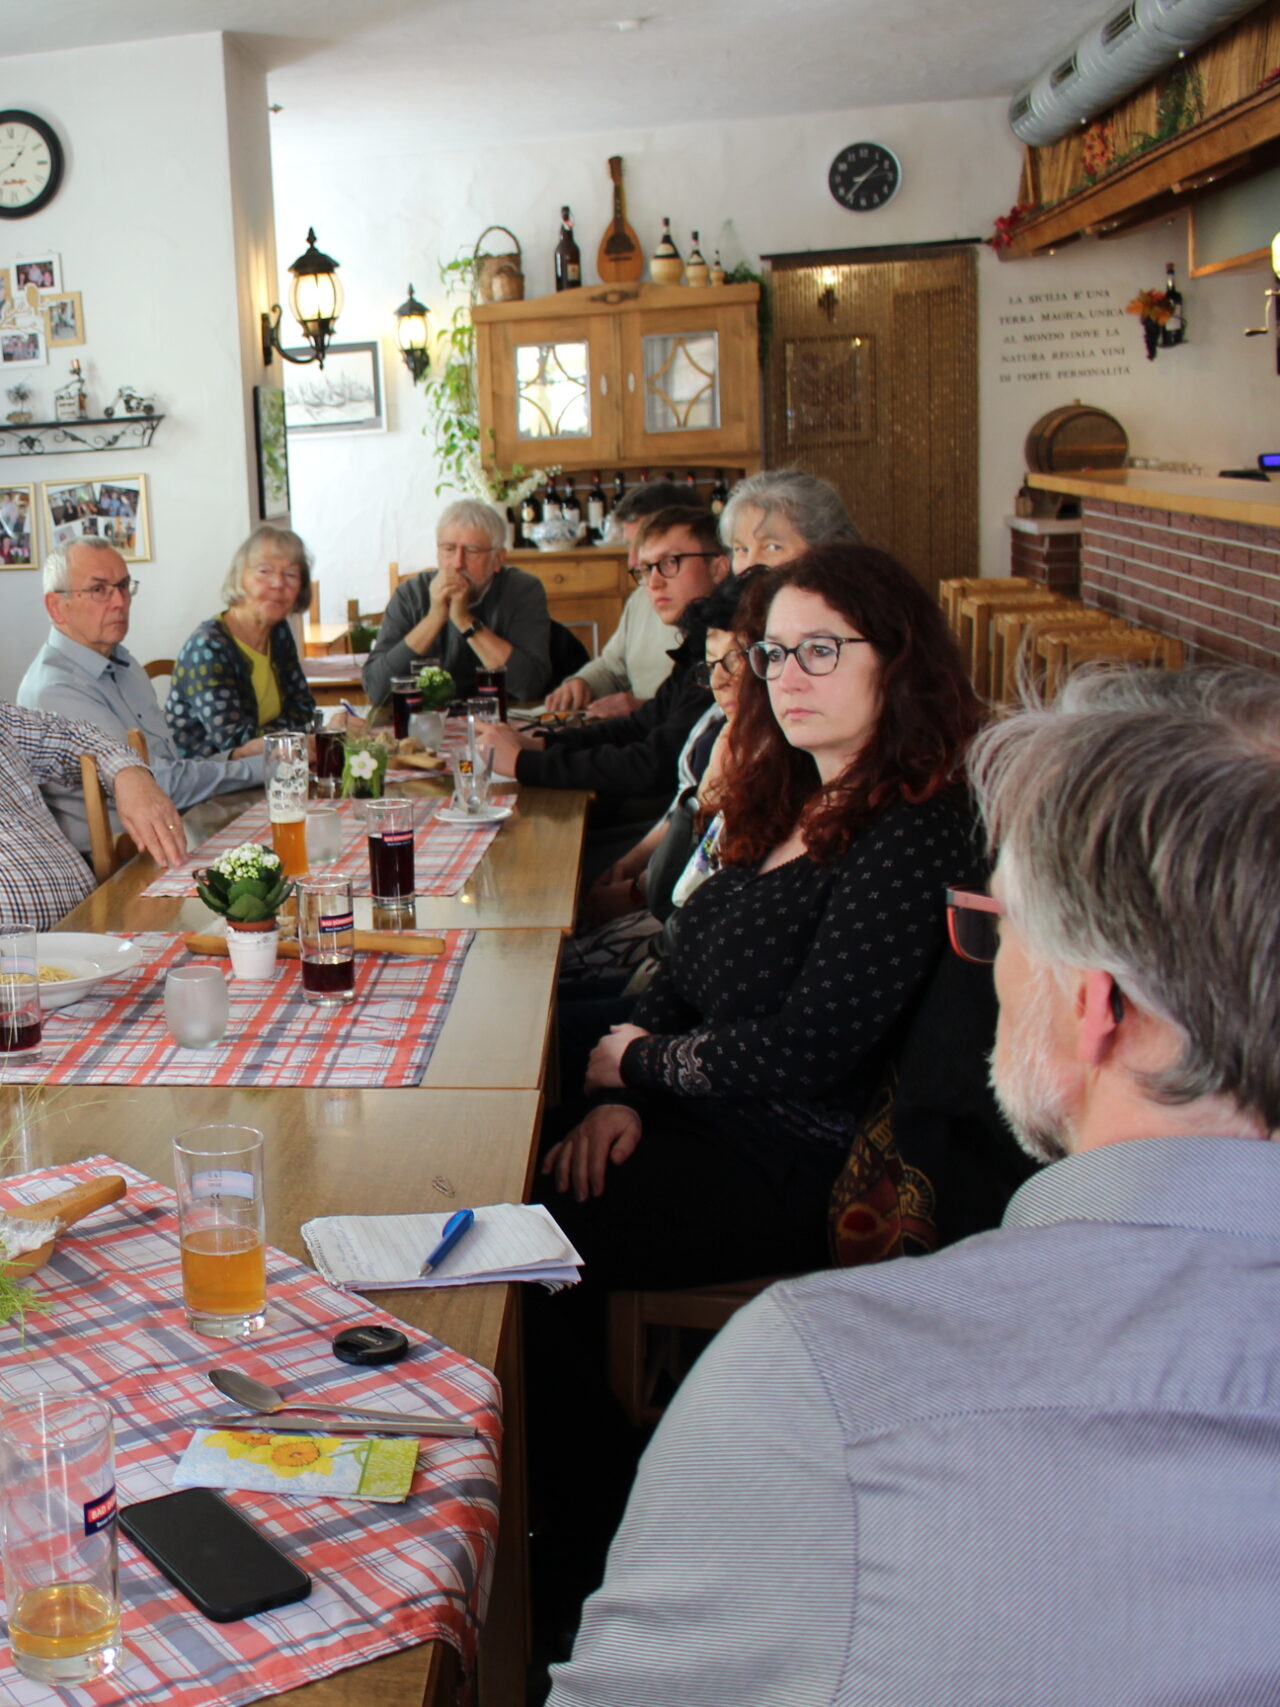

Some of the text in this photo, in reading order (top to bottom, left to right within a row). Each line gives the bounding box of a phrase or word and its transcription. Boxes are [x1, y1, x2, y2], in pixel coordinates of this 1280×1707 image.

[1009, 295, 1022, 305] LA
[1028, 291, 1068, 304] SICILIA
[1086, 288, 1111, 299] UNA
[1000, 315, 1034, 325] TERRA
[1089, 307, 1124, 319] UNICA
[1003, 328, 1120, 344] AL MONDO DOVE LA
[1001, 346, 1126, 364] NATURA REGALA VINI
[999, 373, 1012, 384] DI
[1017, 370, 1052, 383] FORTE
[91, 1504, 107, 1521] BAD
